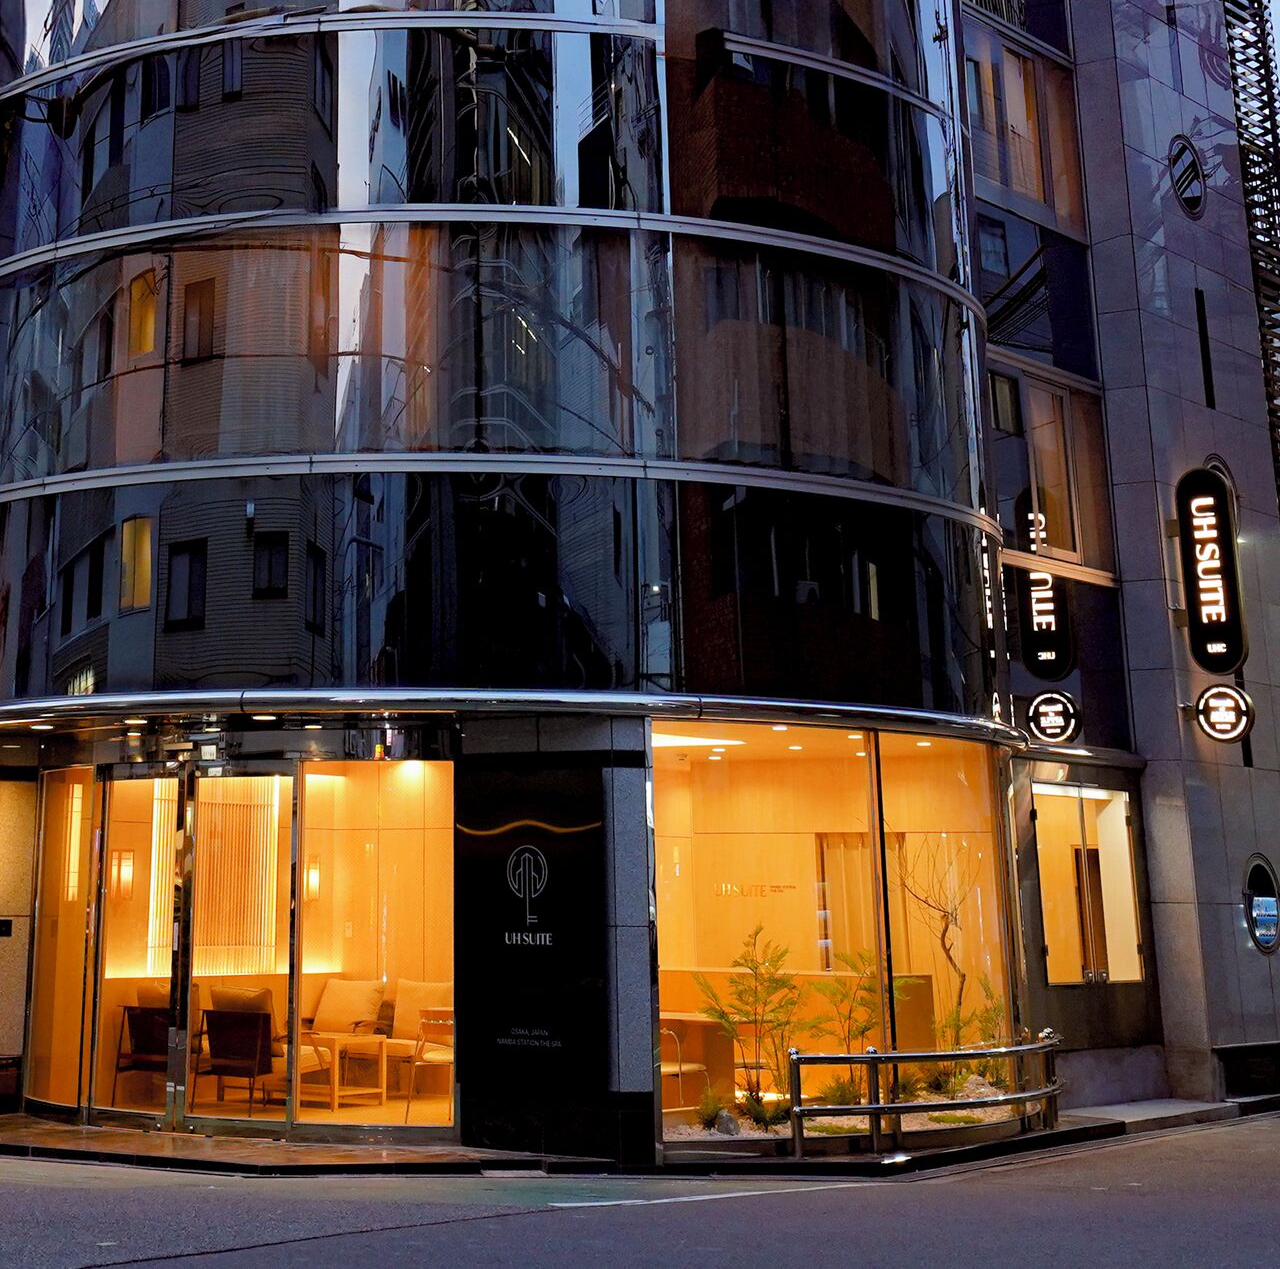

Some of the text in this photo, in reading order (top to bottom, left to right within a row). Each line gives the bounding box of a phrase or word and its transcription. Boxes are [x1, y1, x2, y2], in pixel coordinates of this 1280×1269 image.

[1190, 497, 1226, 623] UH SUITE
[505, 932, 553, 946] UH SUITE
